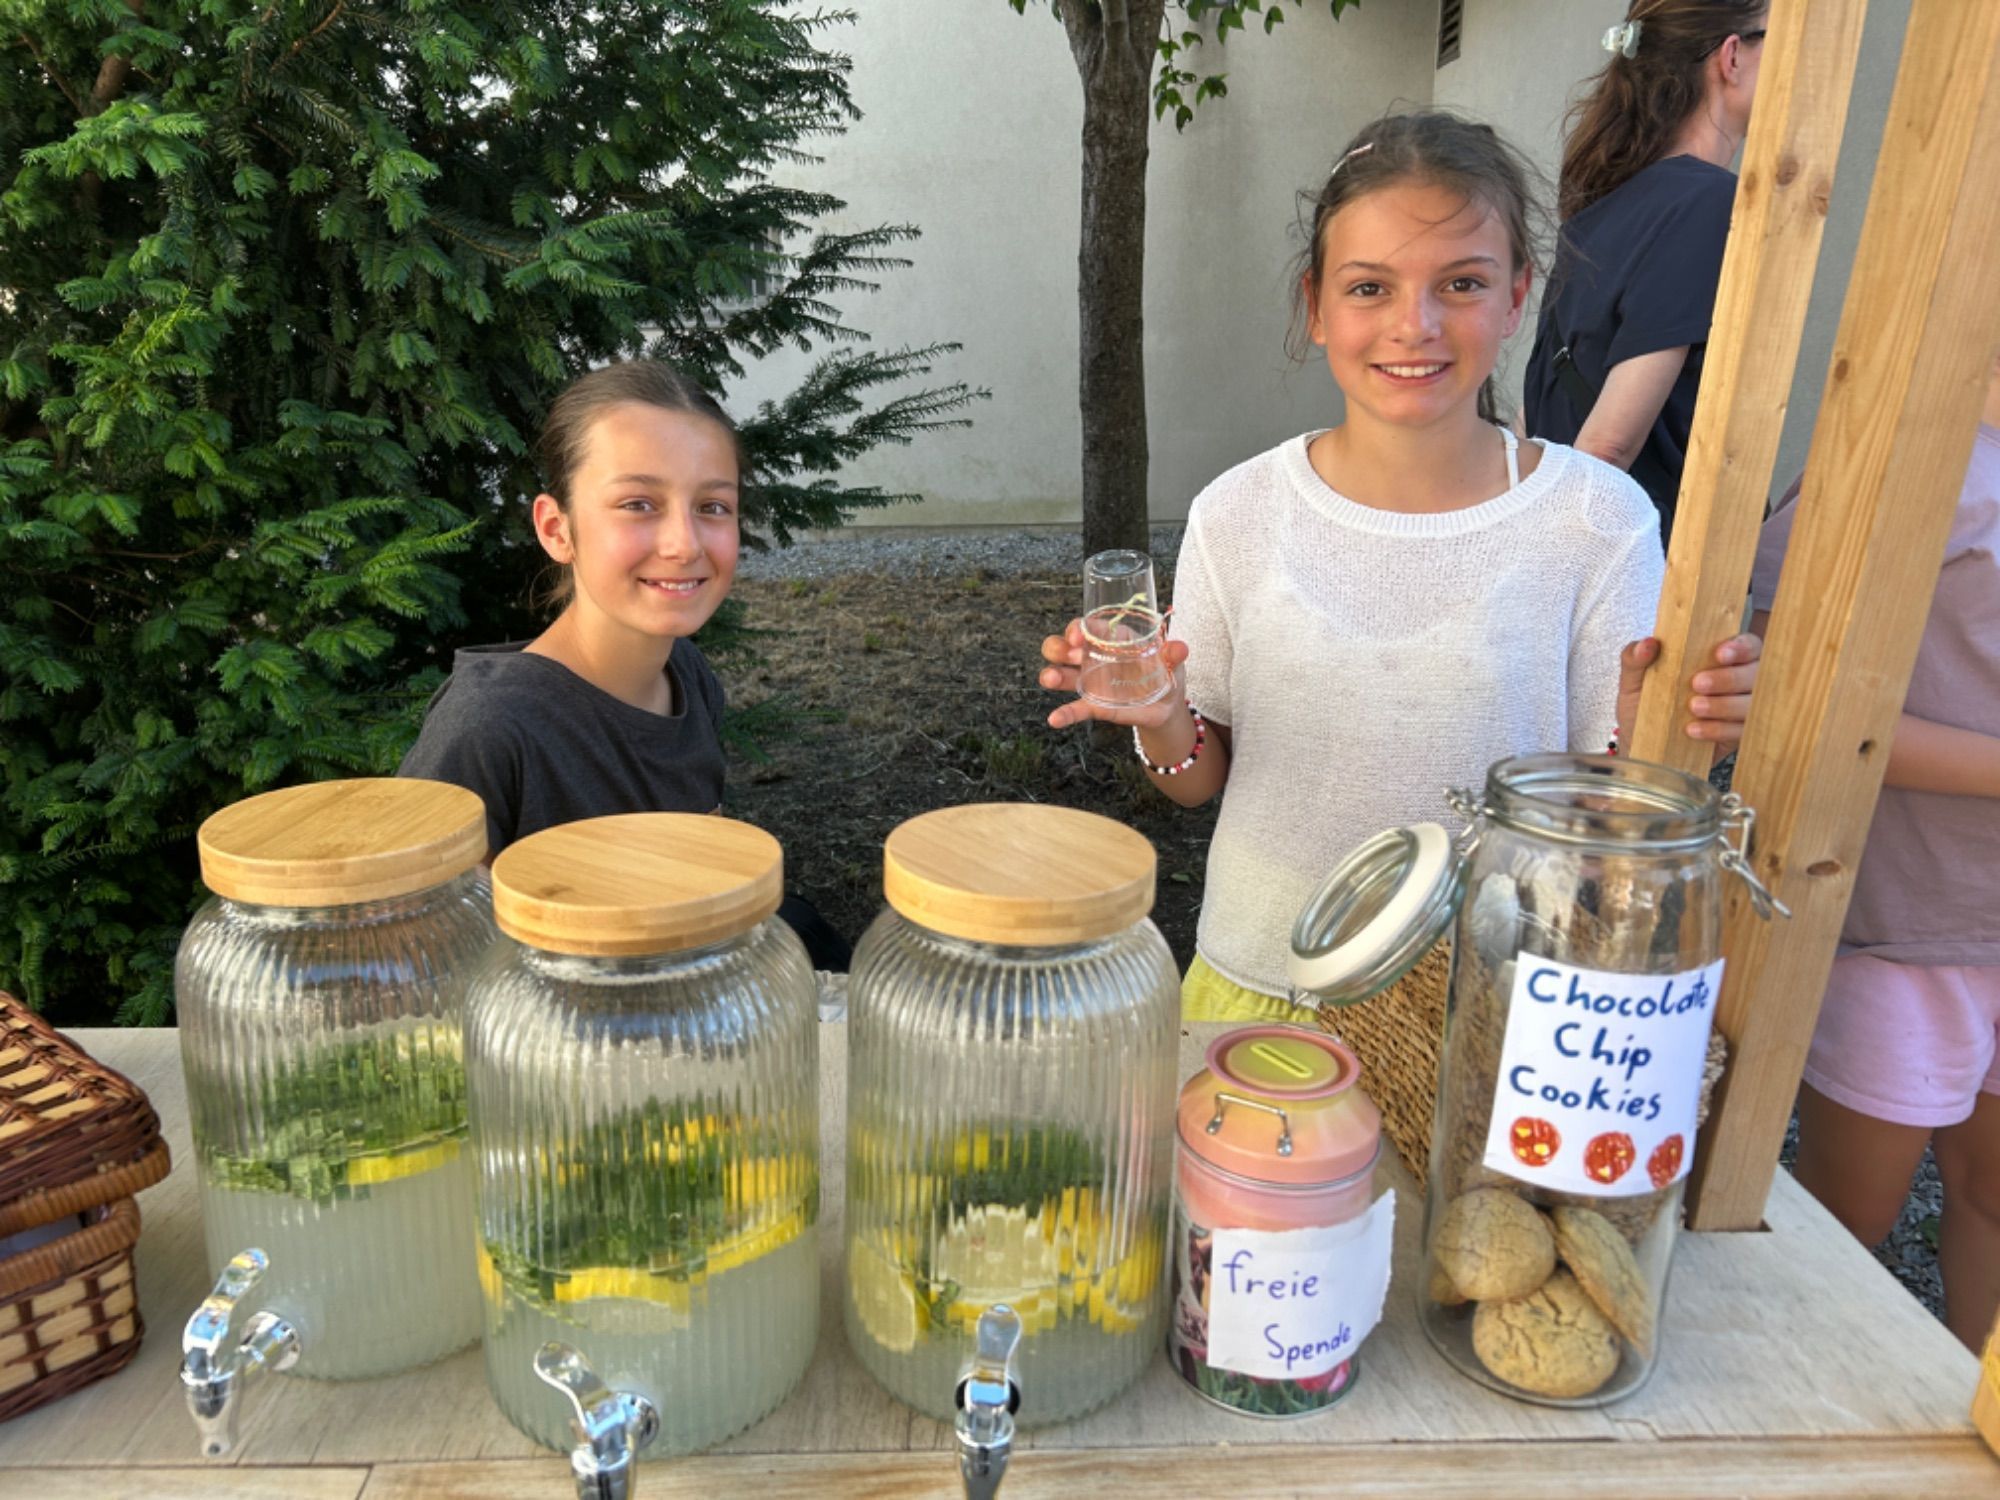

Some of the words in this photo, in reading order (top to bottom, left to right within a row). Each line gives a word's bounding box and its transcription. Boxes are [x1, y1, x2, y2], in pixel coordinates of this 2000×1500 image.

[1527, 968, 1709, 1018] Chocolate
[1554, 1022, 1652, 1080] Chip
[1509, 1065, 1662, 1120] Cookies
[1222, 1250, 1319, 1299] freie
[1264, 1322, 1351, 1370] Spende
